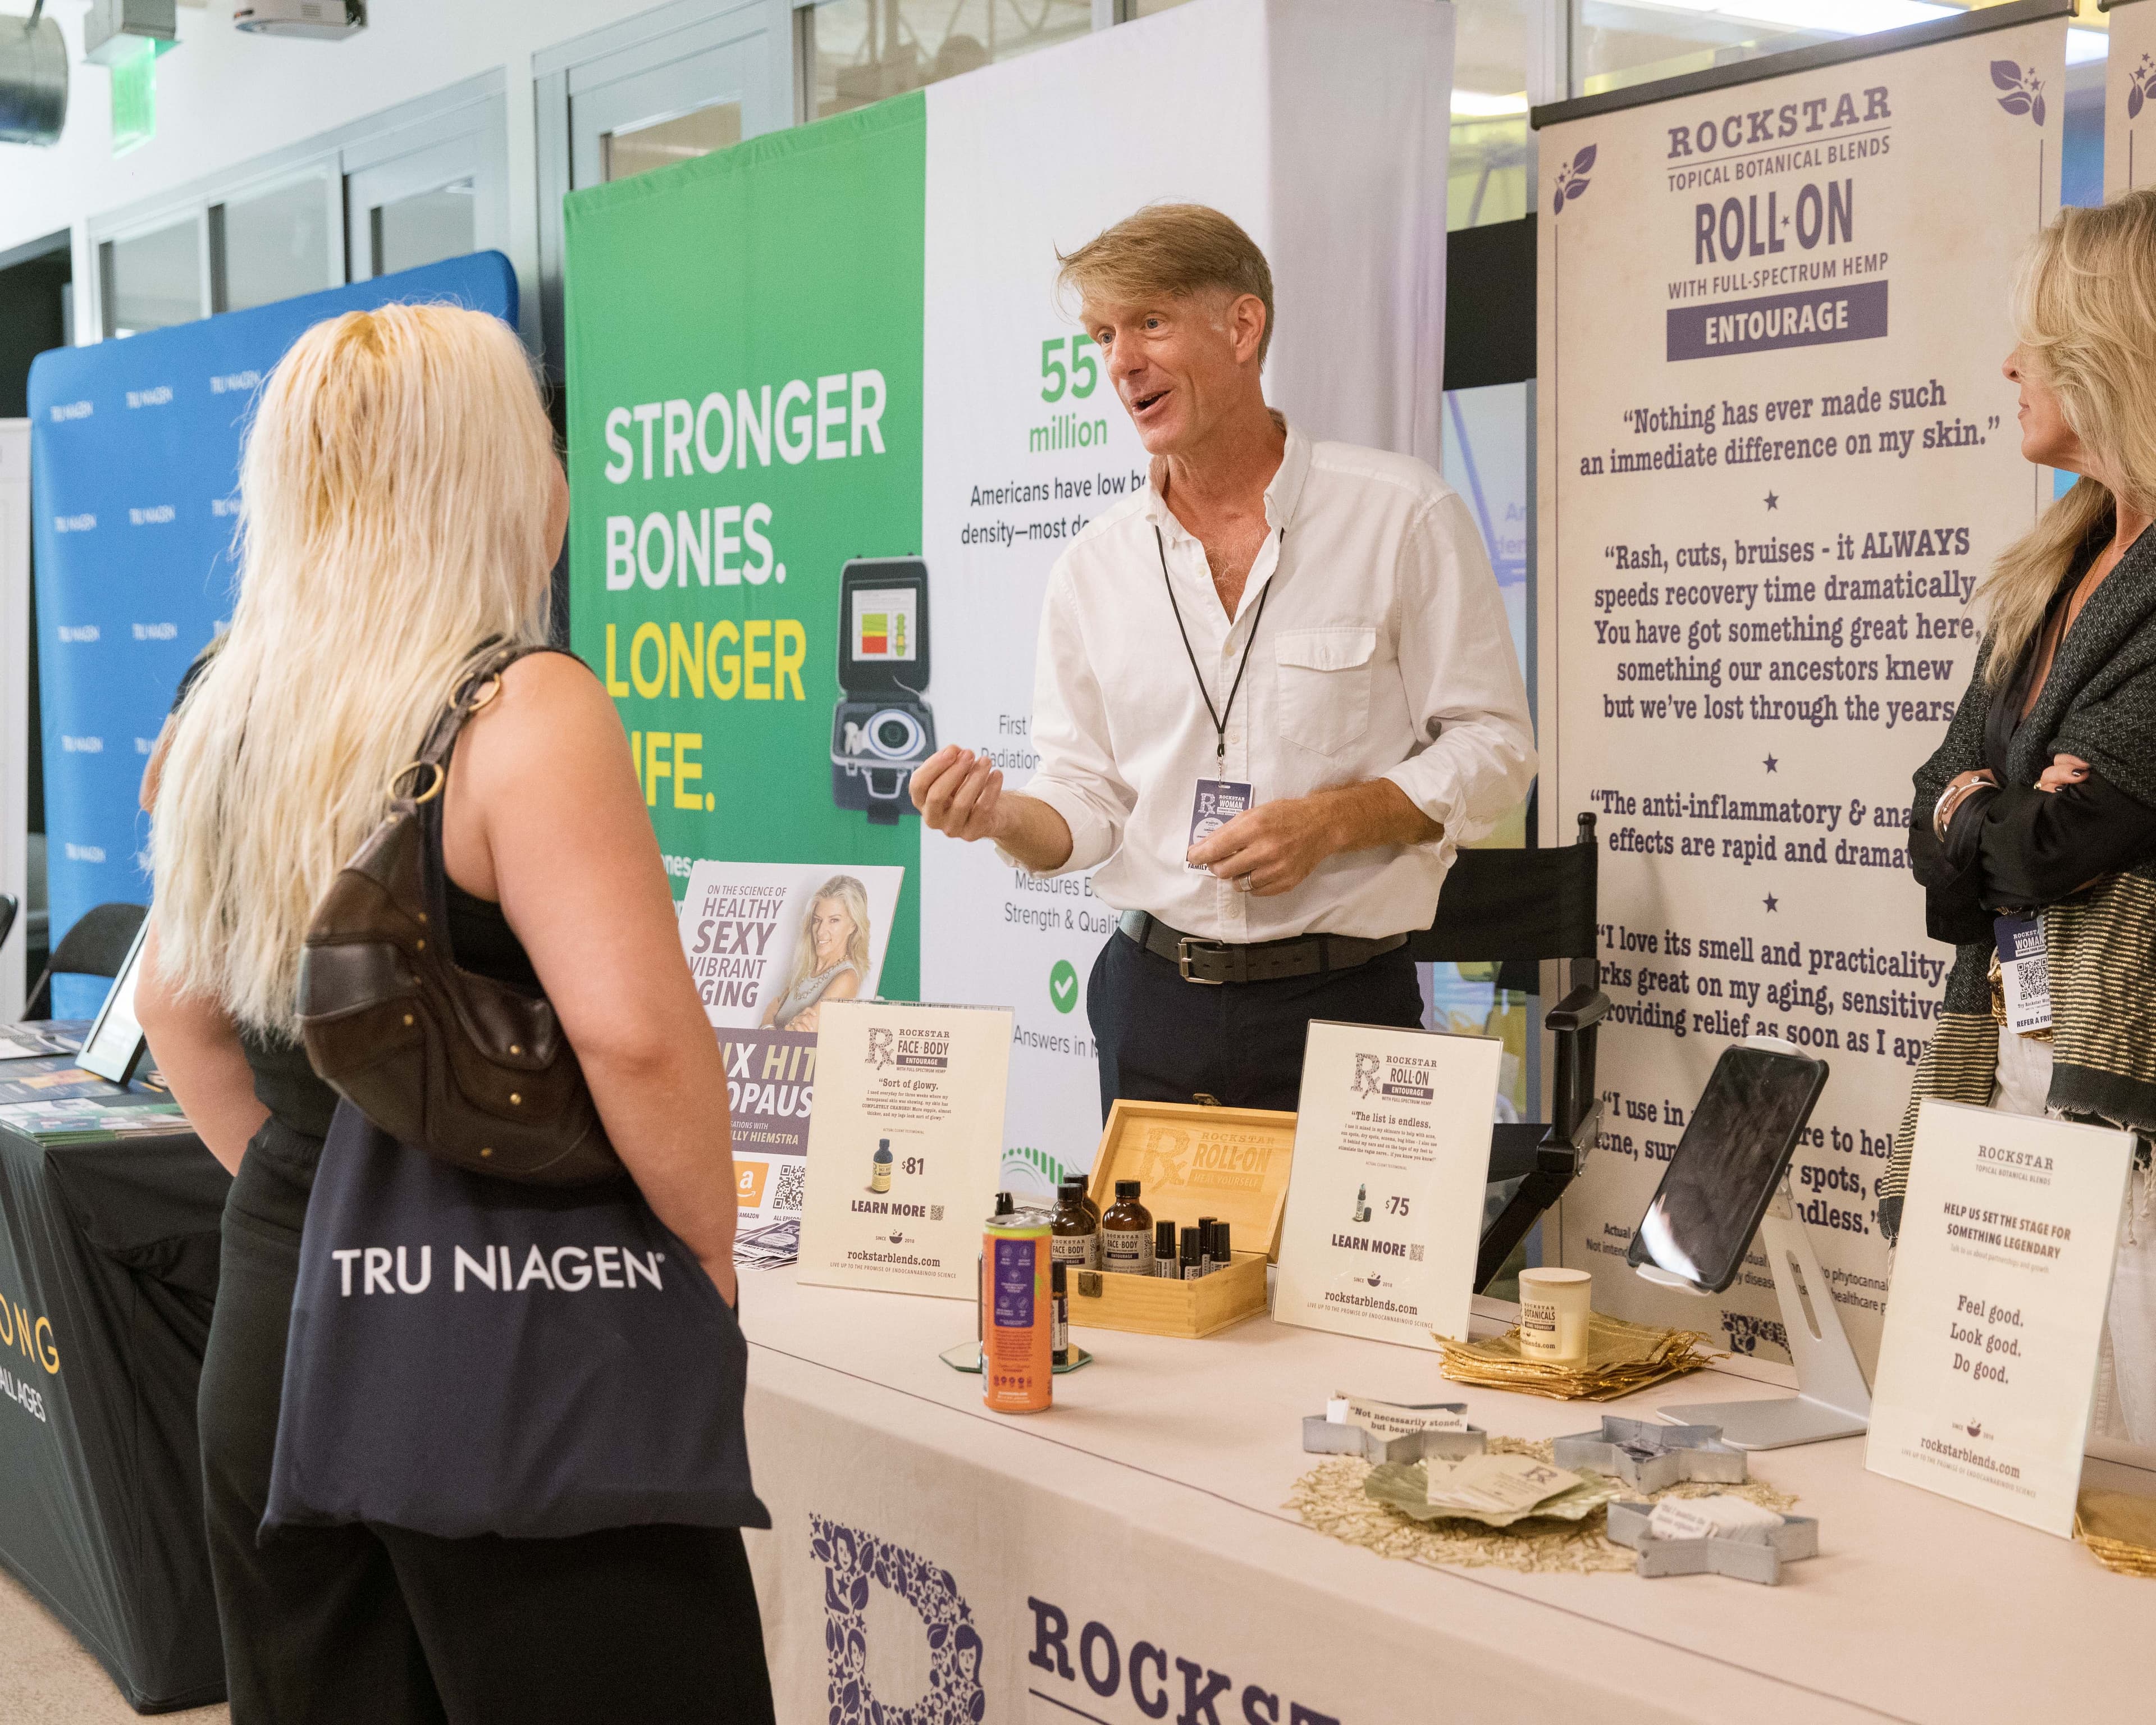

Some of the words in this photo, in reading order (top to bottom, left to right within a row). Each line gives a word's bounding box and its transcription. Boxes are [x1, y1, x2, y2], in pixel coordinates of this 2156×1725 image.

[1667, 85, 1892, 159] ROCKSTAR
[1668, 166, 1730, 191] TOPICAL
[1736, 150, 1823, 181] BOTANICAL
[1828, 135, 1889, 164] BLENDS
[1668, 279, 1706, 299] WITH
[1714, 260, 1835, 294] FULL-SPECTRUM
[1843, 253, 1888, 276] HEMP
[1706, 300, 1848, 344] ENTOURAGE
[1041, 334, 1097, 403] 55
[1624, 403, 1715, 434] “Nothing
[1723, 401, 1758, 426] has
[1766, 398, 1813, 421] ever
[1821, 386, 1881, 417] made
[1889, 379, 1947, 410] such
[605, 369, 886, 483] STRONGER
[1030, 413, 1107, 453] million
[1581, 457, 1604, 476] an
[1610, 442, 1717, 473] immediate
[1725, 436, 1837, 464] difference
[1846, 433, 1872, 455] on
[1879, 430, 1915, 458] my
[971, 481, 1049, 506] Americans
[1055, 478, 1091, 499] have
[1098, 473, 1125, 495] low
[606, 503, 786, 590] BONES.
[1605, 544, 1668, 573] “Rash,
[1677, 542, 1726, 571] cuts,
[1735, 537, 1814, 564] bruises
[1837, 533, 1854, 560] it
[1861, 527, 1970, 559] ALWAYS
[1595, 582, 1659, 613] speeds
[1666, 585, 1758, 610] recovery
[1764, 576, 1815, 603] time
[1825, 570, 1976, 605] dramatically
[1595, 620, 1630, 644] You
[1636, 619, 1680, 644] have
[1688, 619, 1721, 650] got
[1729, 614, 1843, 648] something
[1851, 614, 1908, 647] great
[1916, 613, 1981, 644] here,
[606, 619, 806, 700] LONGER
[1618, 655, 1721, 688] something
[1729, 662, 1762, 681] our
[1770, 656, 1878, 681] ancestors
[1886, 654, 1953, 681] knew
[999, 715, 1026, 735] First
[1604, 694, 1634, 718] but
[1704, 694, 1743, 719] lost
[1750, 695, 1838, 728] through
[1845, 695, 1879, 721] the
[1886, 699, 1955, 729] years
[633, 731, 715, 813] IFE.
[1220, 800, 1243, 809] WOMAN
[1591, 790, 1636, 815] “The
[1643, 792, 1842, 832] anti-inflammatory
[1849, 799, 1866, 825] &
[707, 885, 720, 894] ON
[723, 886, 738, 895] THE
[739, 886, 774, 896] SCIENCE
[775, 887, 787, 896] OF
[1015, 870, 1079, 896] Measures
[702, 897, 783, 919] HEALTHY
[1005, 902, 1060, 932] Strength
[1065, 911, 1074, 929] &
[692, 920, 776, 955] SEXY
[689, 957, 767, 979] VIBRANT
[695, 979, 759, 1007] GING
[899, 1029, 950, 1038] ROCKSTAR
[2017, 1018, 2034, 1028] REFER
[1013, 1025, 1070, 1053] Answers
[1075, 1041, 1085, 1056] in
[1386, 1056, 1437, 1067] ROCKSTAR
[879, 1078, 900, 1088] “Sort
[913, 1080, 938, 1092] glowy.
[1392, 1087, 1423, 1096] ENTOURAGE
[1352, 1111, 1370, 1121] “The
[1373, 1113, 1386, 1123] list
[1389, 1115, 1396, 1124] is
[1399, 1117, 1431, 1129] endless.
[750, 1131, 798, 1144] HIEMSTRA
[1202, 1132, 1275, 1144] ROCKSTAR
[902, 1157, 924, 1175] $81
[1978, 1145, 2053, 1170] ROCKSTAR
[1195, 1174, 1214, 1183] HEAL
[1218, 1177, 1257, 1186] YOURSELF
[1976, 1165, 1997, 1175] TOPICAL
[1999, 1169, 2028, 1181] BOTANICAL
[2030, 1176, 2051, 1185] BLENDS
[852, 1200, 888, 1214] LEARN
[892, 1203, 925, 1217] MORE
[1386, 1196, 1410, 1216] $75
[1944, 1202, 1966, 1217] HELP
[1969, 1207, 1980, 1220] US
[1983, 1211, 1999, 1224] SET
[2000, 1215, 2017, 1228] THE
[2020, 1219, 2049, 1235] STAGE
[2051, 1226, 2071, 1240] FOR
[1332, 1234, 1369, 1251] LEARN
[1372, 1240, 1406, 1257] MORE
[1947, 1223, 2001, 1245] SOMETHING
[2004, 1236, 2061, 1259] LEGENDARY
[332, 1245, 431, 1296] TRU
[848, 1251, 940, 1267] rockstarblends.com
[1325, 1292, 1418, 1315] rockstarblends.com
[1341, 1308, 1360, 1316] PROMISE
[1369, 1312, 1413, 1325] ENDOCANNABINOID
[1414, 1320, 1433, 1329] SCIENCE
[1524, 1308, 1555, 1320] BOTANICALS
[1957, 1295, 1985, 1317] Feel
[1988, 1305, 2023, 1326] good.
[1951, 1322, 1983, 1347] Look
[1986, 1334, 2021, 1357] good.
[1953, 1353, 1970, 1372] Do
[1974, 1361, 2009, 1384] good.
[17, 1379, 45, 1422] AGES
[1371, 1422, 1385, 1431] but
[1374, 1414, 1426, 1426] necessarily
[1921, 1437, 2020, 1479] rockstarblends.com
